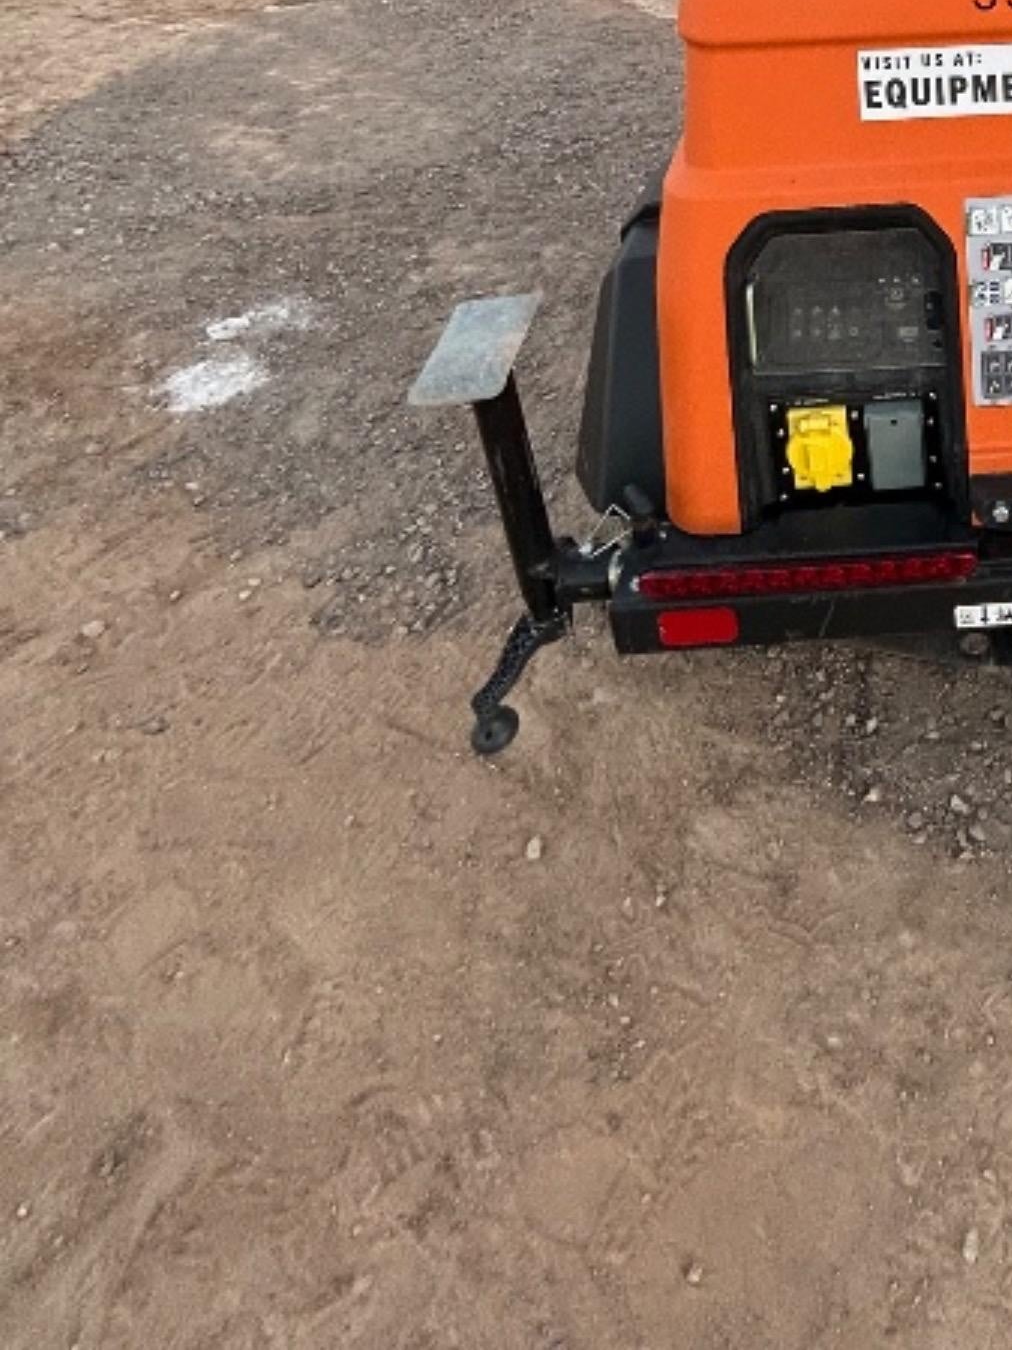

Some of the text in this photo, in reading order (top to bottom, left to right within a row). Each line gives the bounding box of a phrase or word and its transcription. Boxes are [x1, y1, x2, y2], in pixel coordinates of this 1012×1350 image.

[861, 53, 983, 70] VISIT US AT:
